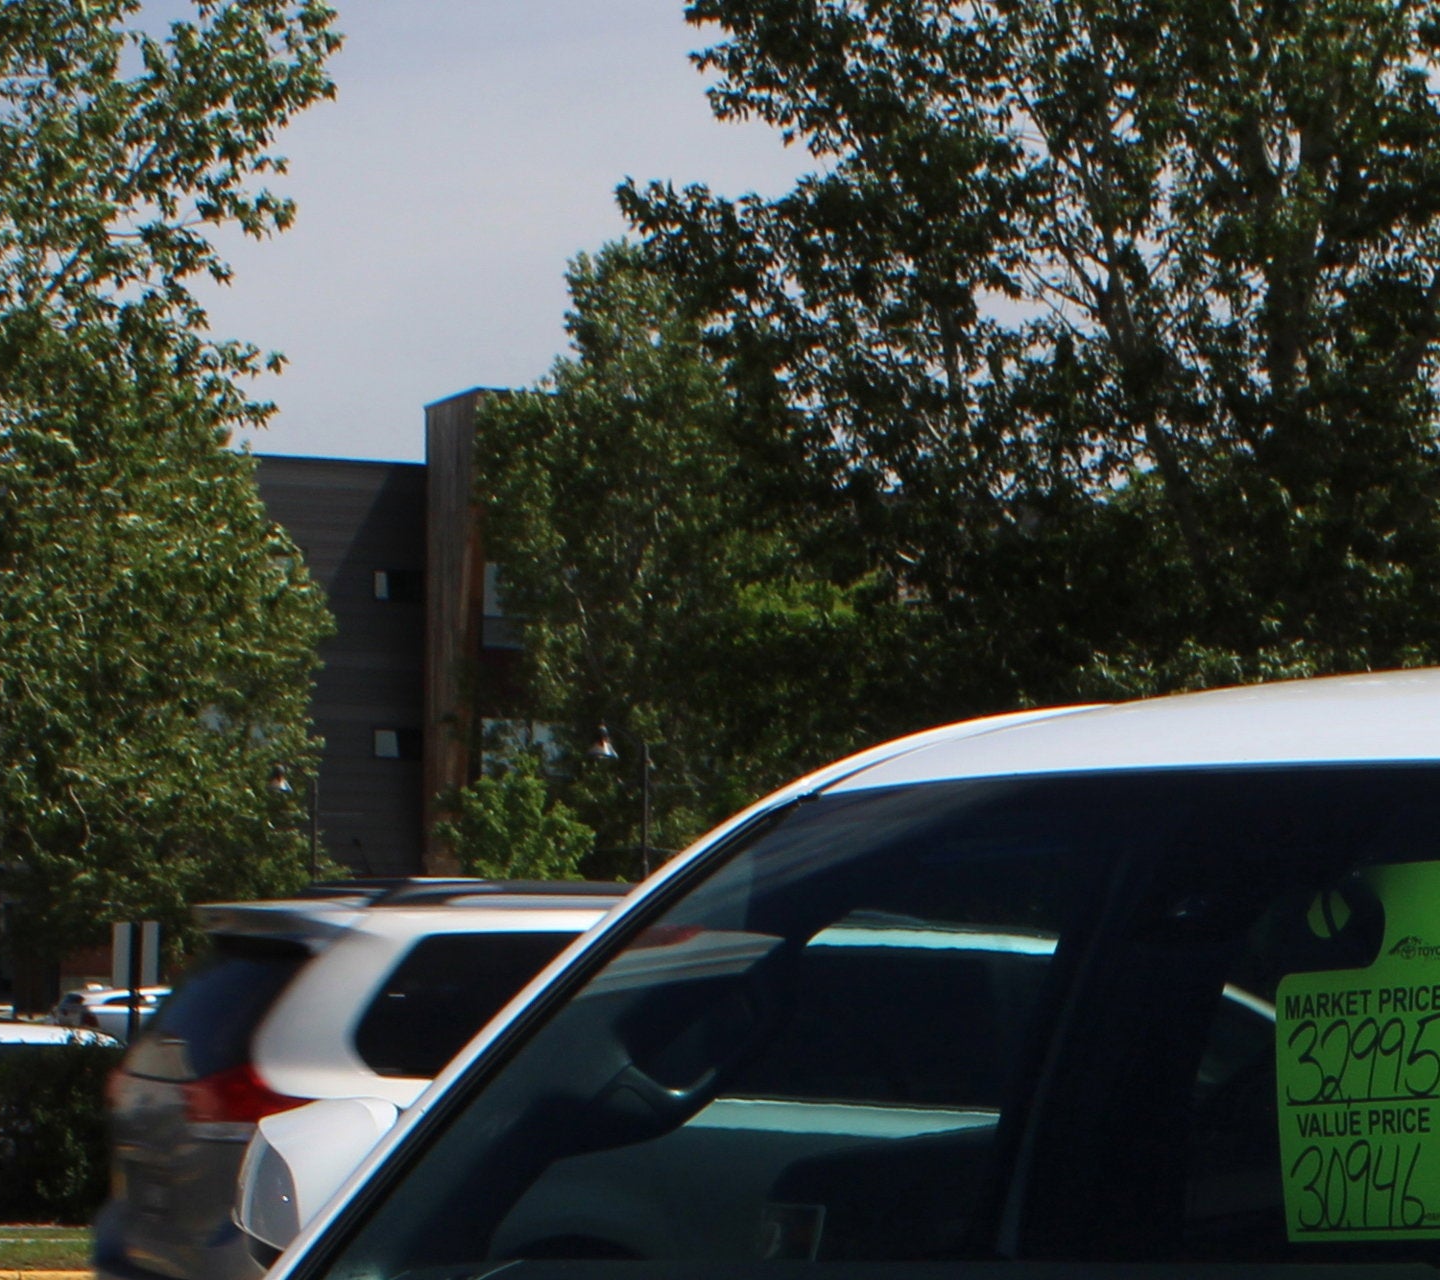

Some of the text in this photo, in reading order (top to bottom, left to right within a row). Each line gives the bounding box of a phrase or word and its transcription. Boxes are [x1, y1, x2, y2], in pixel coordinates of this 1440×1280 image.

[1285, 989, 1372, 1020] MARKET
[1296, 1107, 1431, 1138] VALUE PRICE
